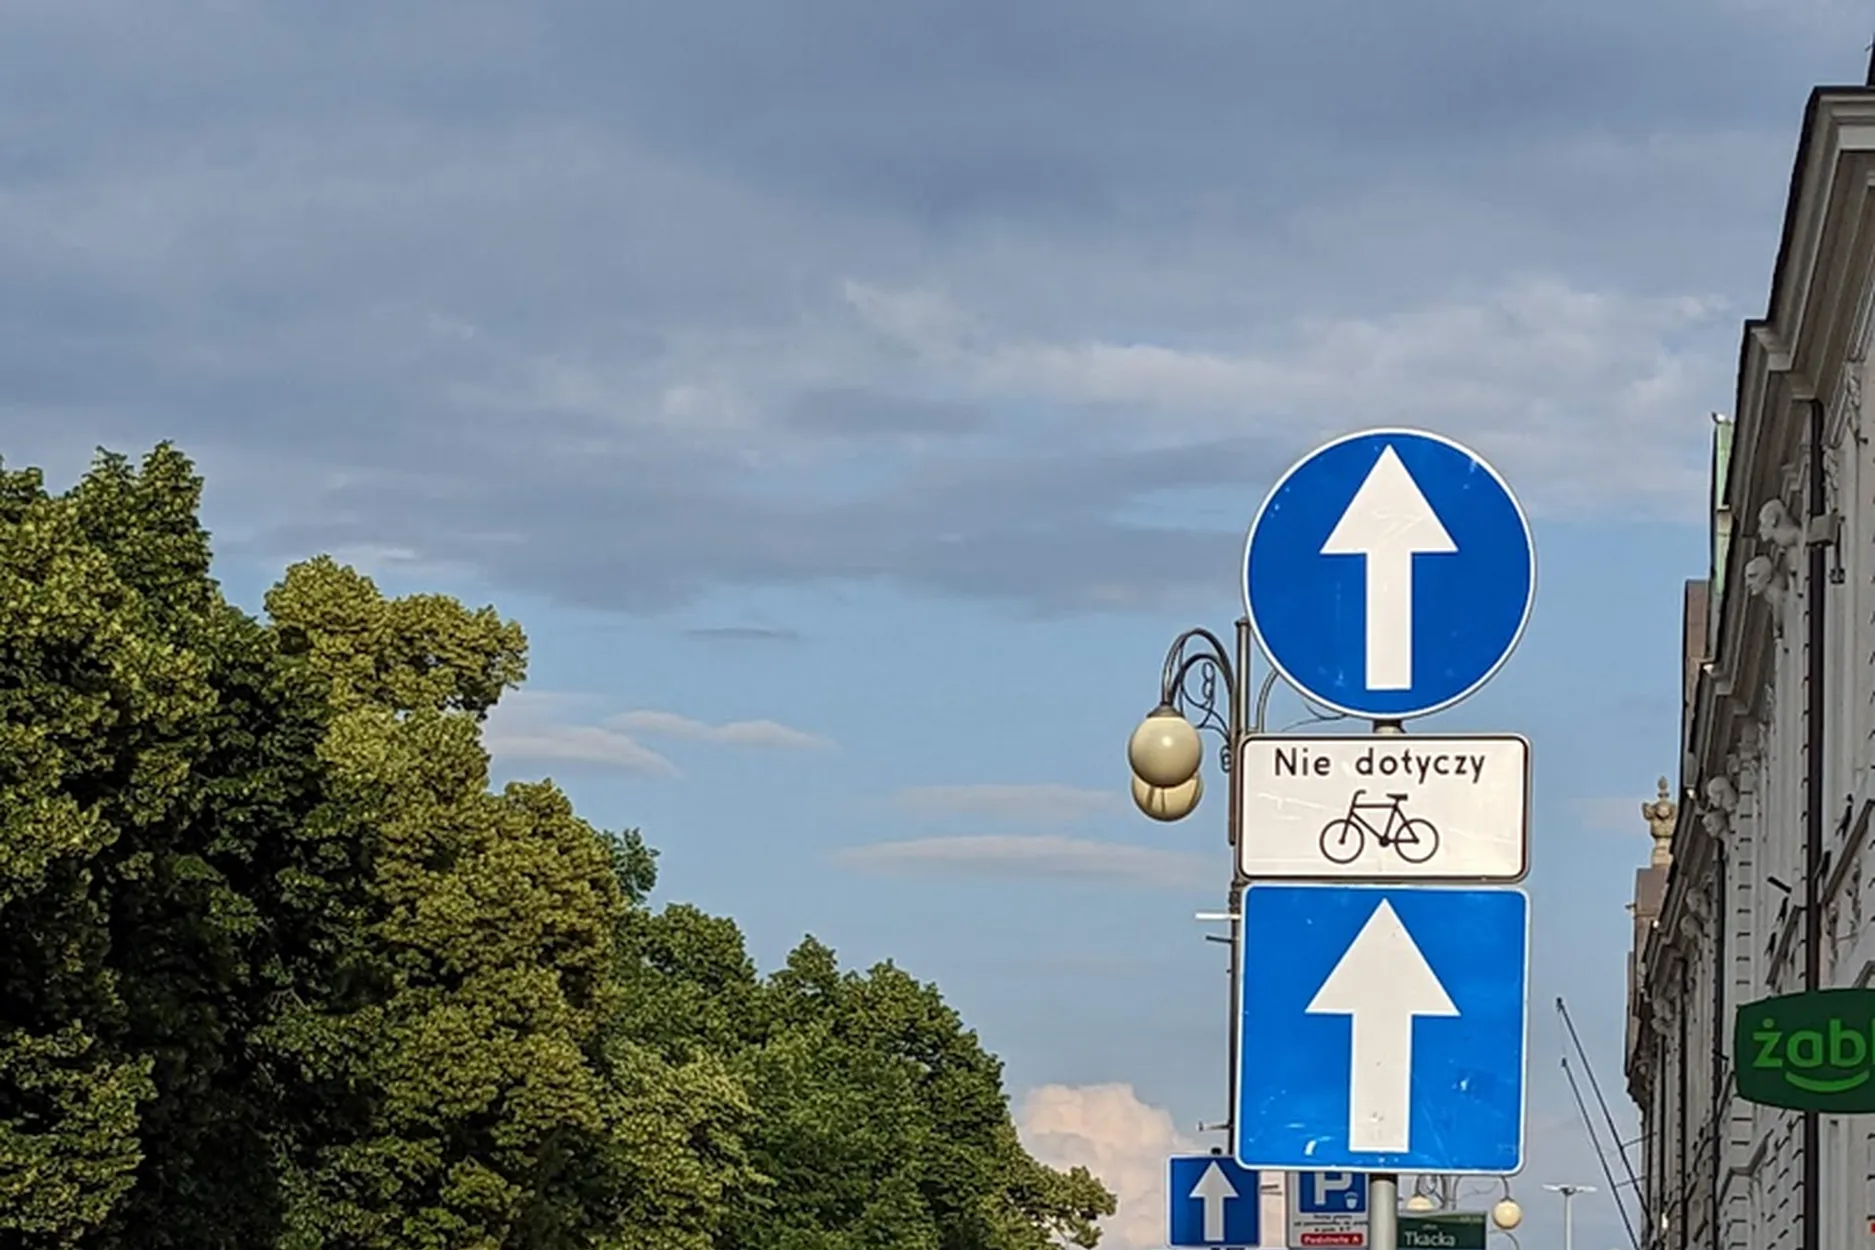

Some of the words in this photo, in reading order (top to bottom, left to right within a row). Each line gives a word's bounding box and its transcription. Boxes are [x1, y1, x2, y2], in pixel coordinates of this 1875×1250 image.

[1274, 747, 1332, 777] Nie
[1355, 747, 1486, 785] dotyczy
[1752, 1018, 1875, 1069] żab
[1404, 1231, 1456, 1248] Tkacka
